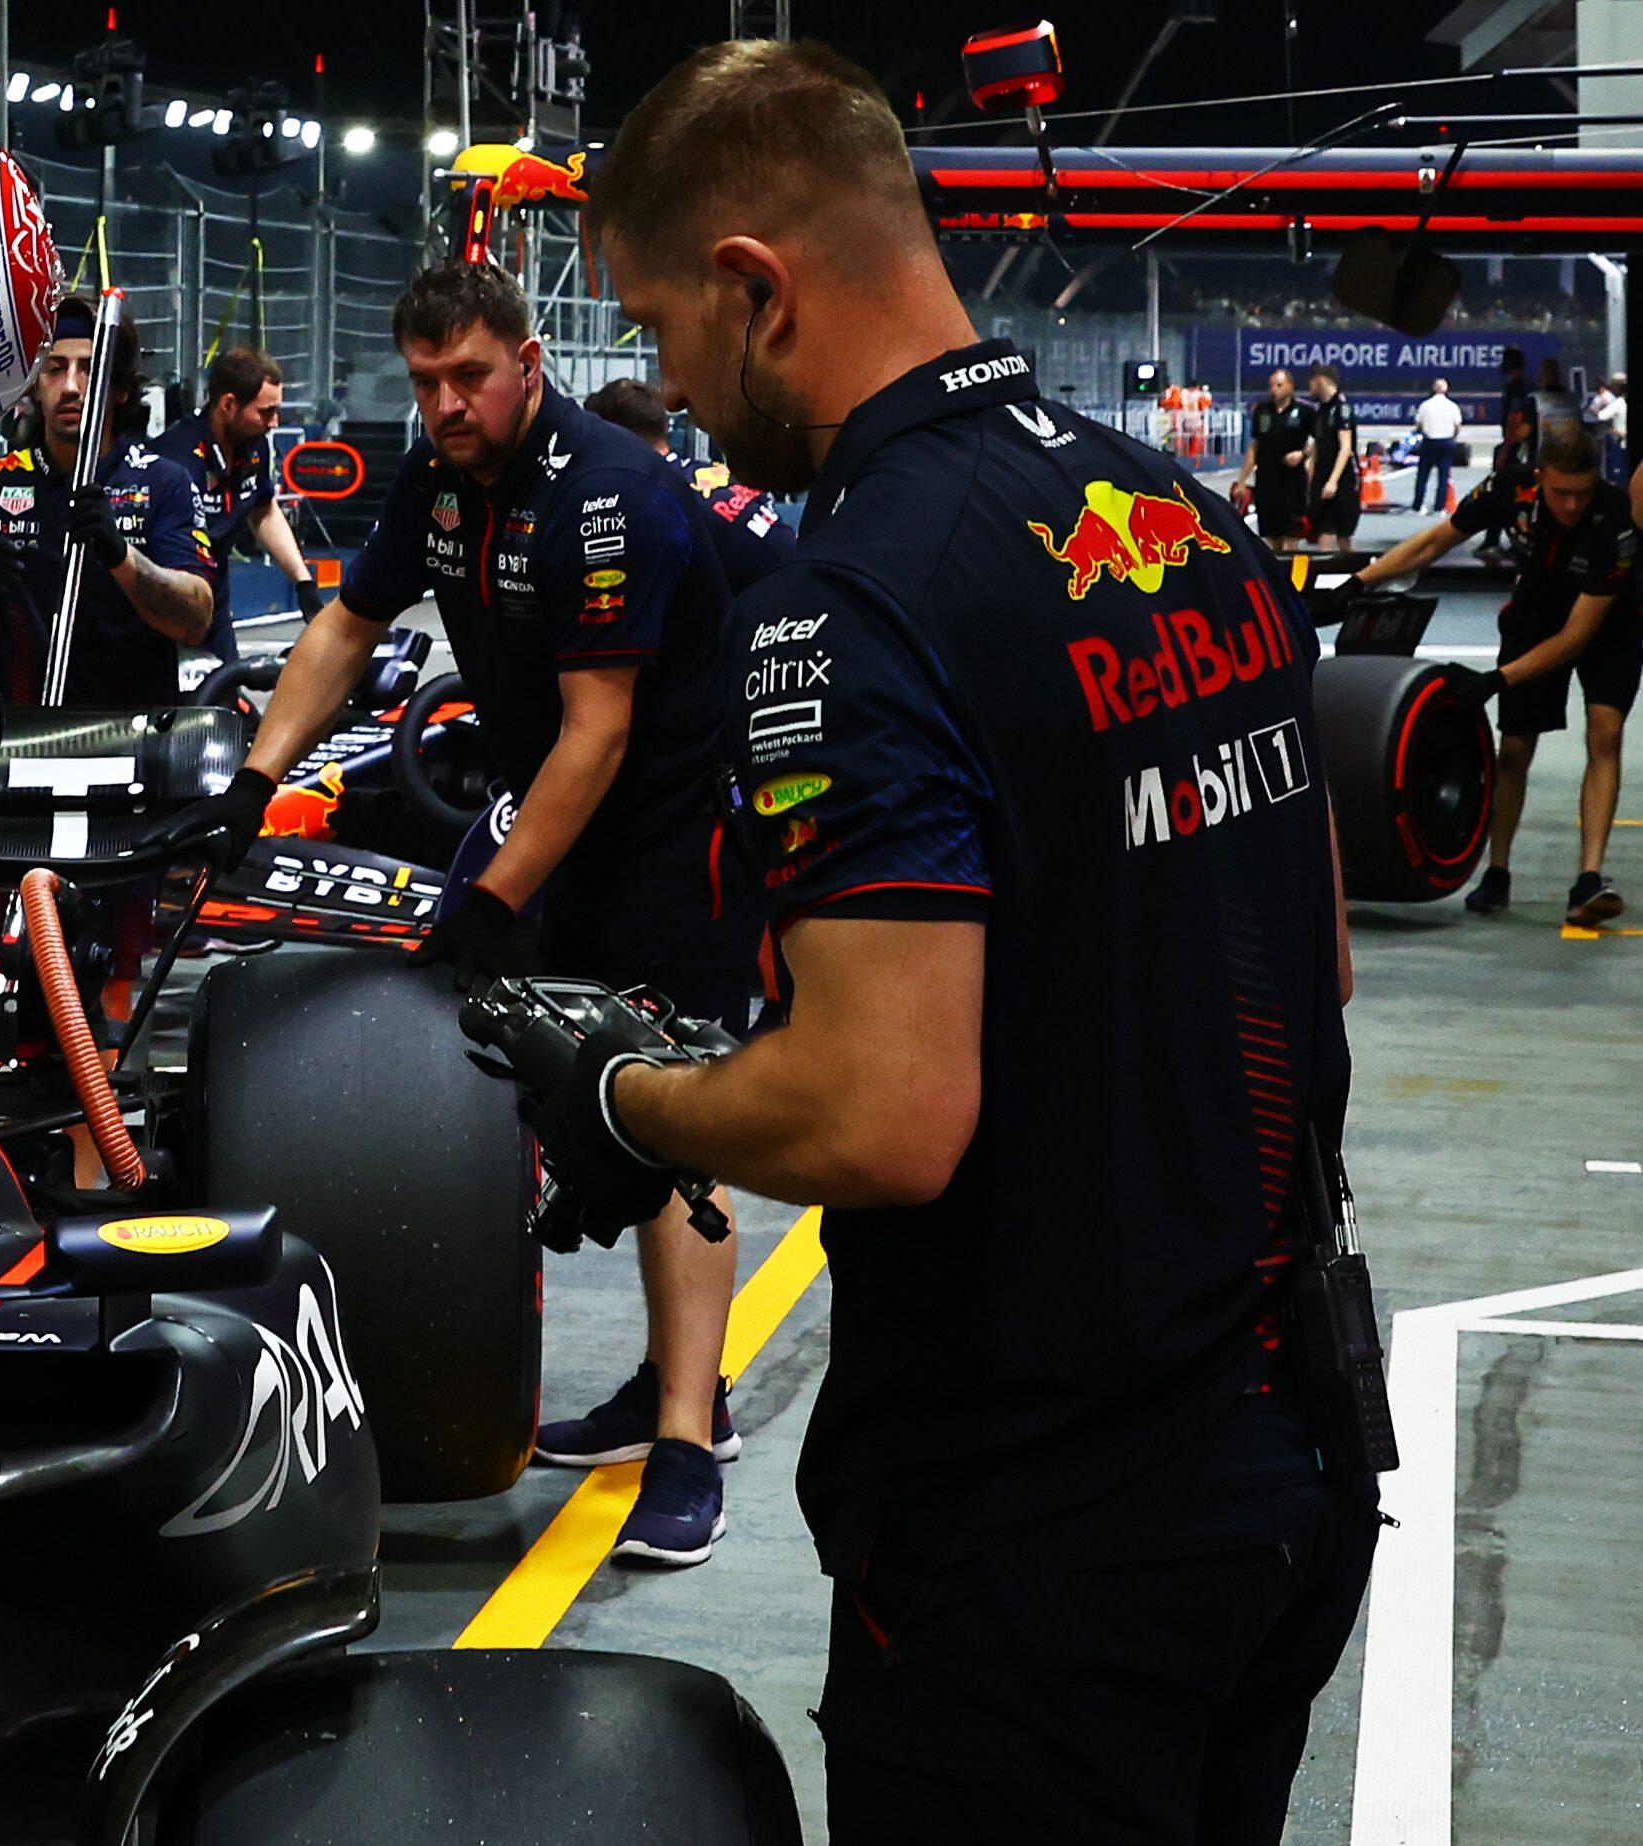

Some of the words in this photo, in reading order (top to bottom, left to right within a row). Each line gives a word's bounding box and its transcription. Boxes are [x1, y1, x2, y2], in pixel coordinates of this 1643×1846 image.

[1250, 343, 1389, 367] SINGAPORE
[1397, 343, 1504, 367] AIRLINES
[939, 355, 1030, 392] HONDA
[582, 494, 619, 514] telcel
[115, 515, 145, 531] YBIT
[580, 512, 626, 536] citrix
[750, 613, 828, 651] telcel
[745, 650, 831, 700] citrix
[1126, 739, 1251, 850] Mobil
[132, 1221, 213, 1239] RAUCH
